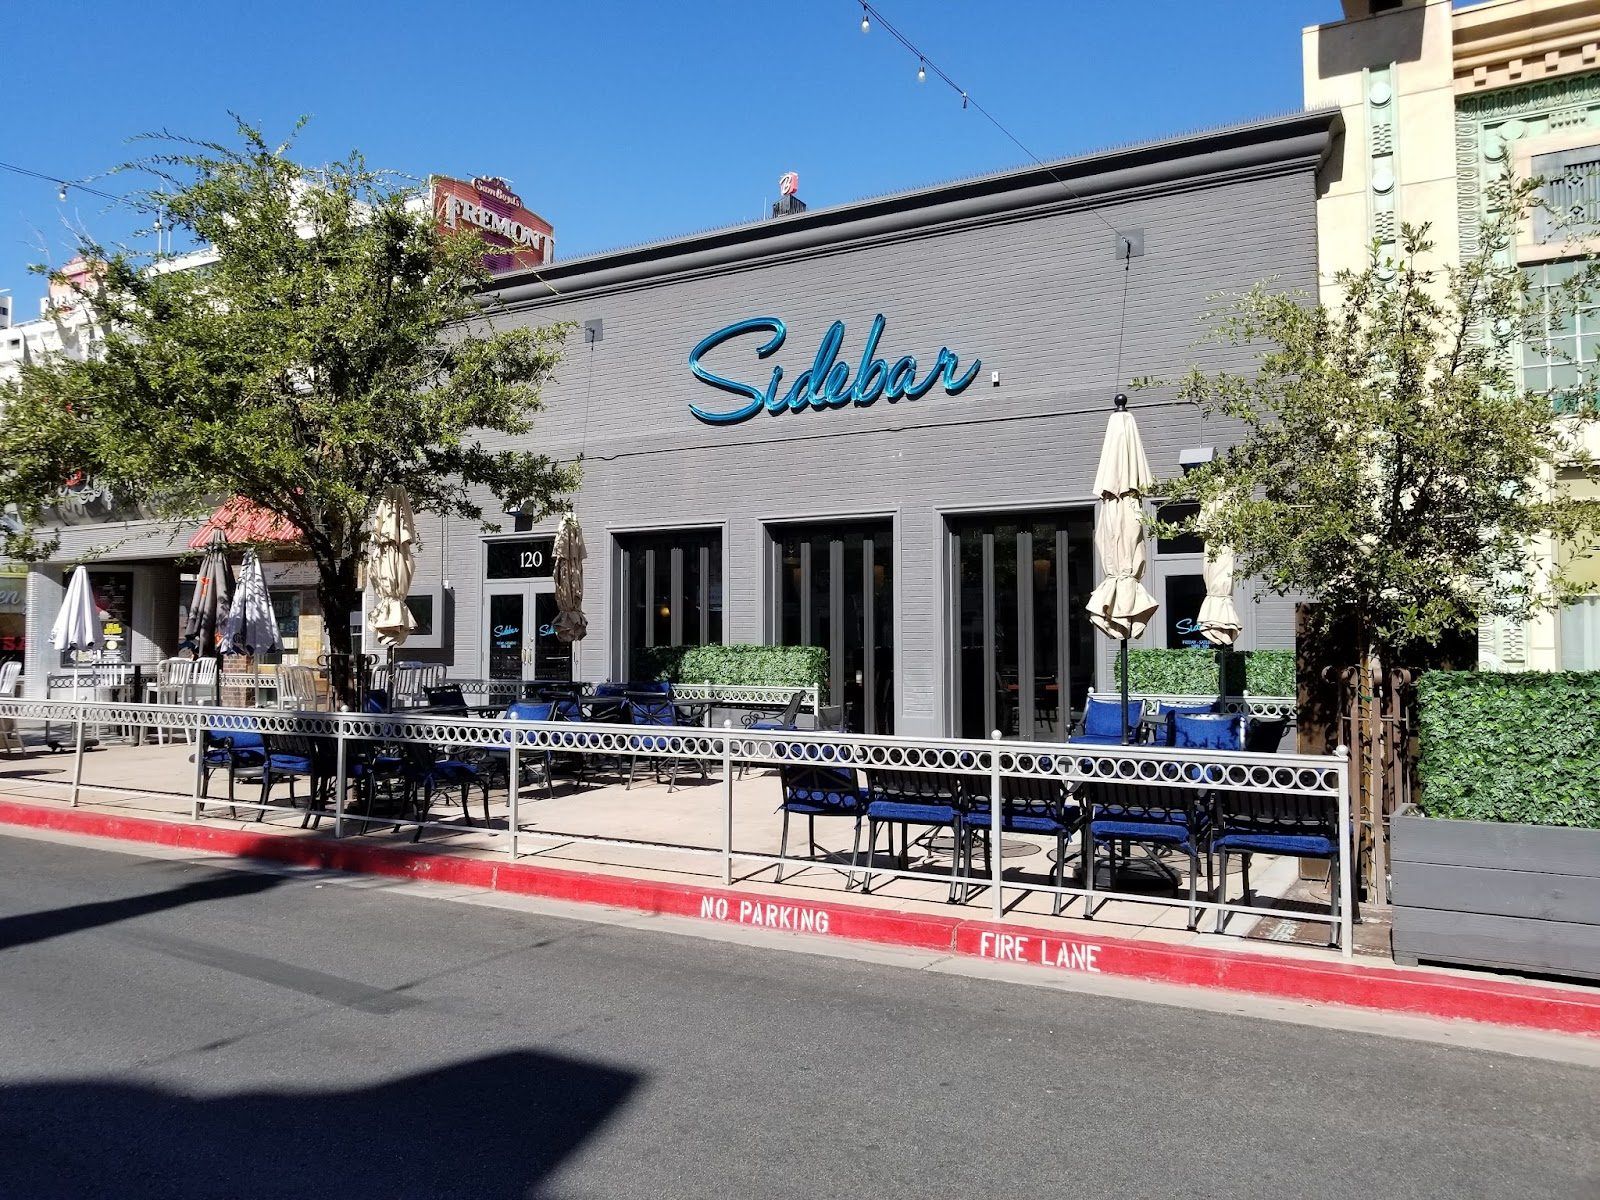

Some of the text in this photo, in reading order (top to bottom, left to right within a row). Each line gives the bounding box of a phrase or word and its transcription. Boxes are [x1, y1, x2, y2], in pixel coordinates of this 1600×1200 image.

[441, 192, 554, 265] FREMONT
[688, 313, 981, 424] Sidebar
[520, 551, 543, 568] 120
[700, 895, 829, 933] NO PARKING
[980, 931, 1101, 973] FIRE LANE
